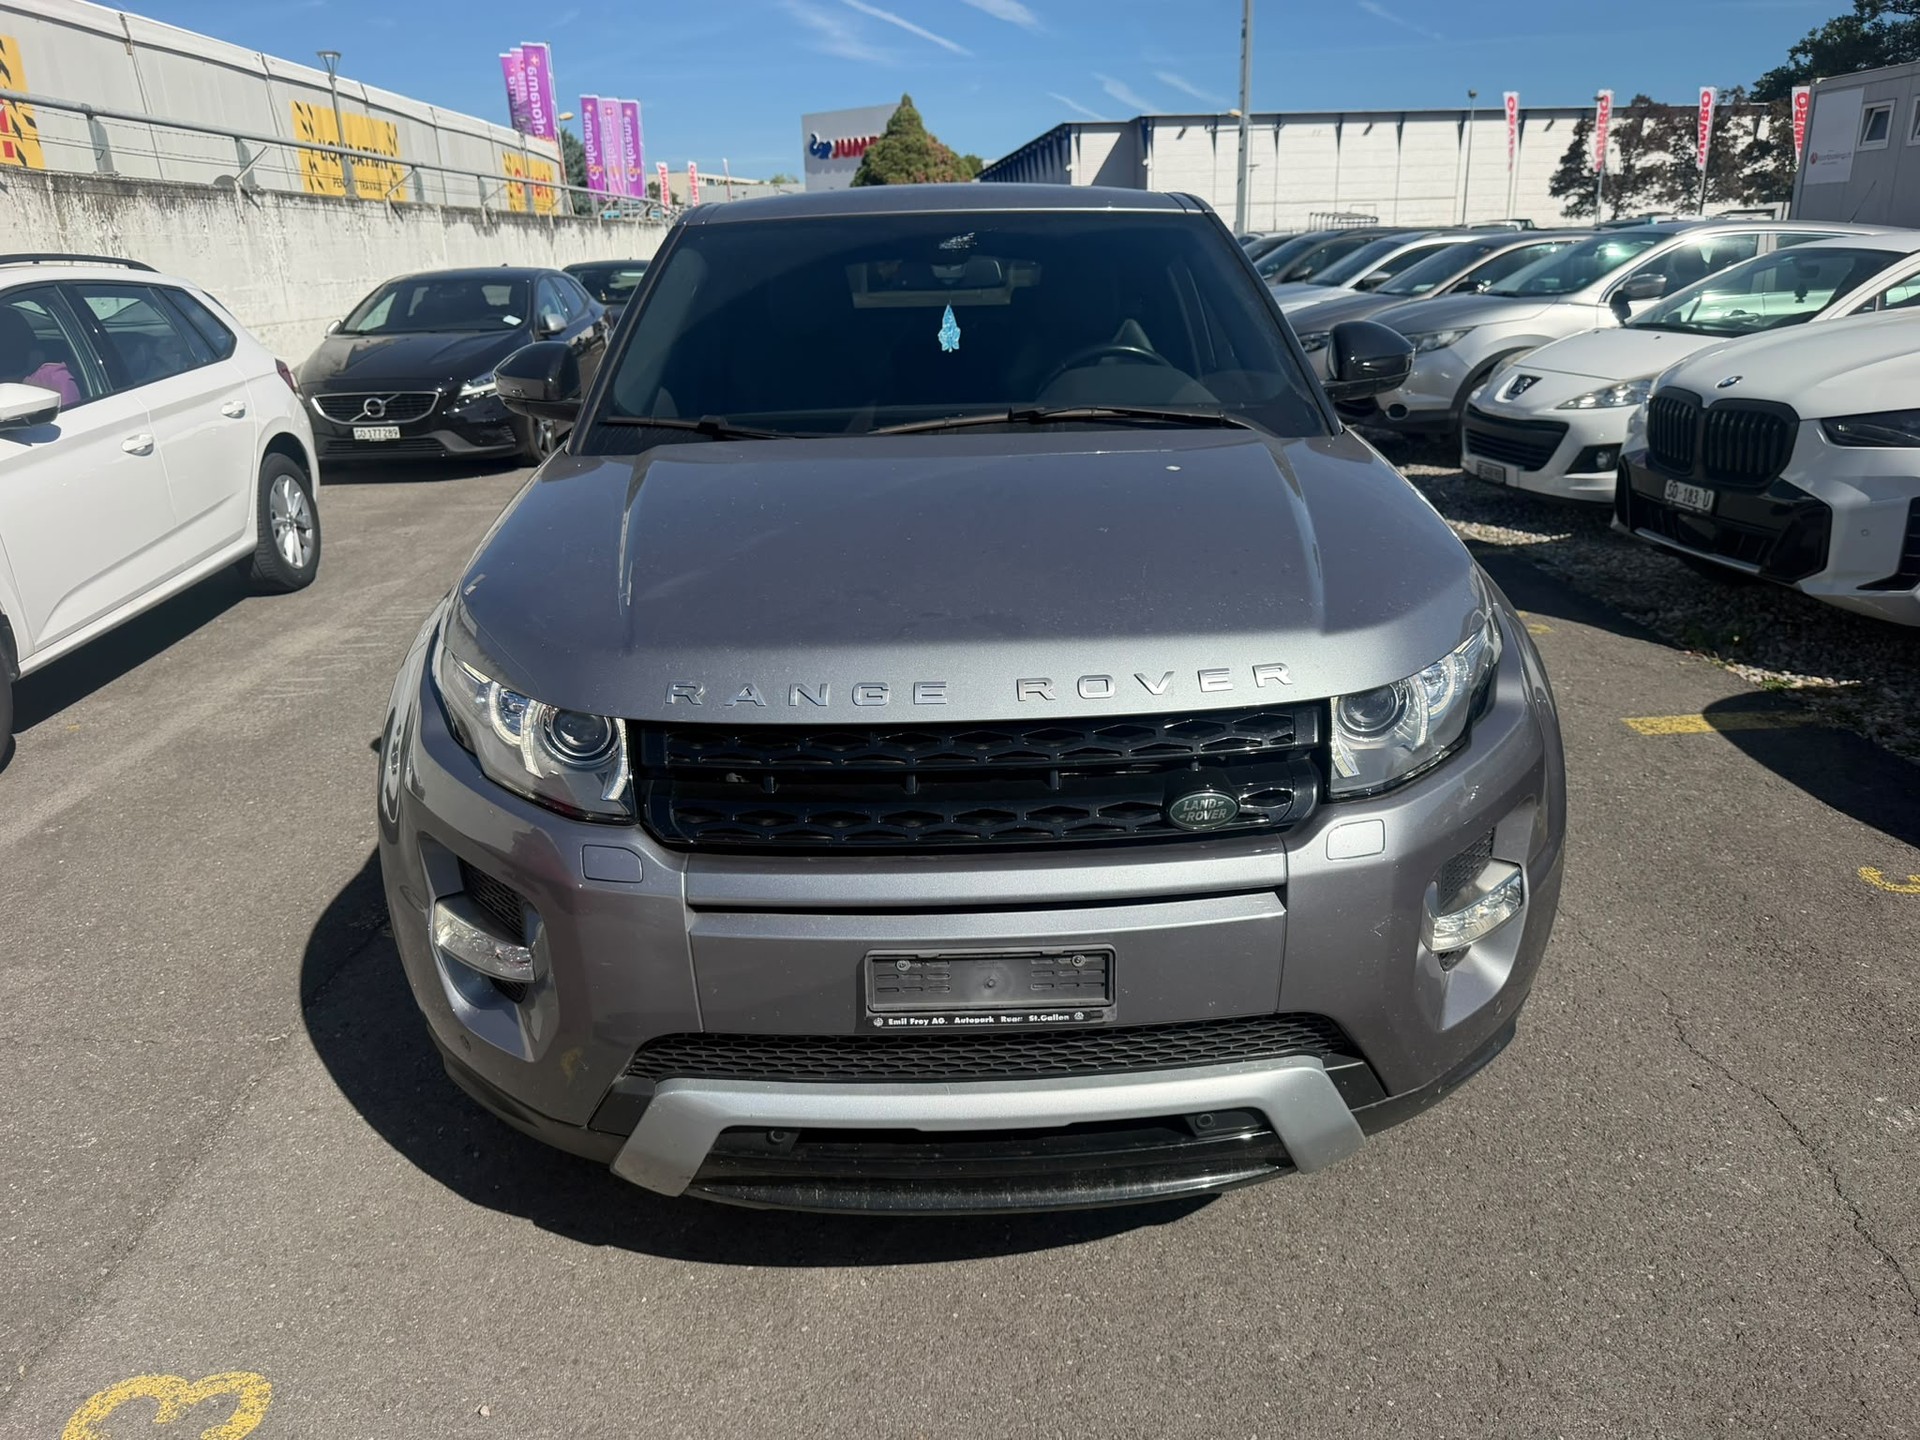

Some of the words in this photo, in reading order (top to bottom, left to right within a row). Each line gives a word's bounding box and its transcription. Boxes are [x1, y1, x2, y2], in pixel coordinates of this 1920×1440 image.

[318, 138, 388, 169] LIQDATION
[665, 680, 948, 706] RANGE
[1016, 662, 1294, 701] ROVER
[1183, 798, 1217, 811] LAND
[1186, 808, 1227, 821] ROVER
[888, 1017, 907, 1026] Emil
[954, 1015, 995, 1024] Autopark
